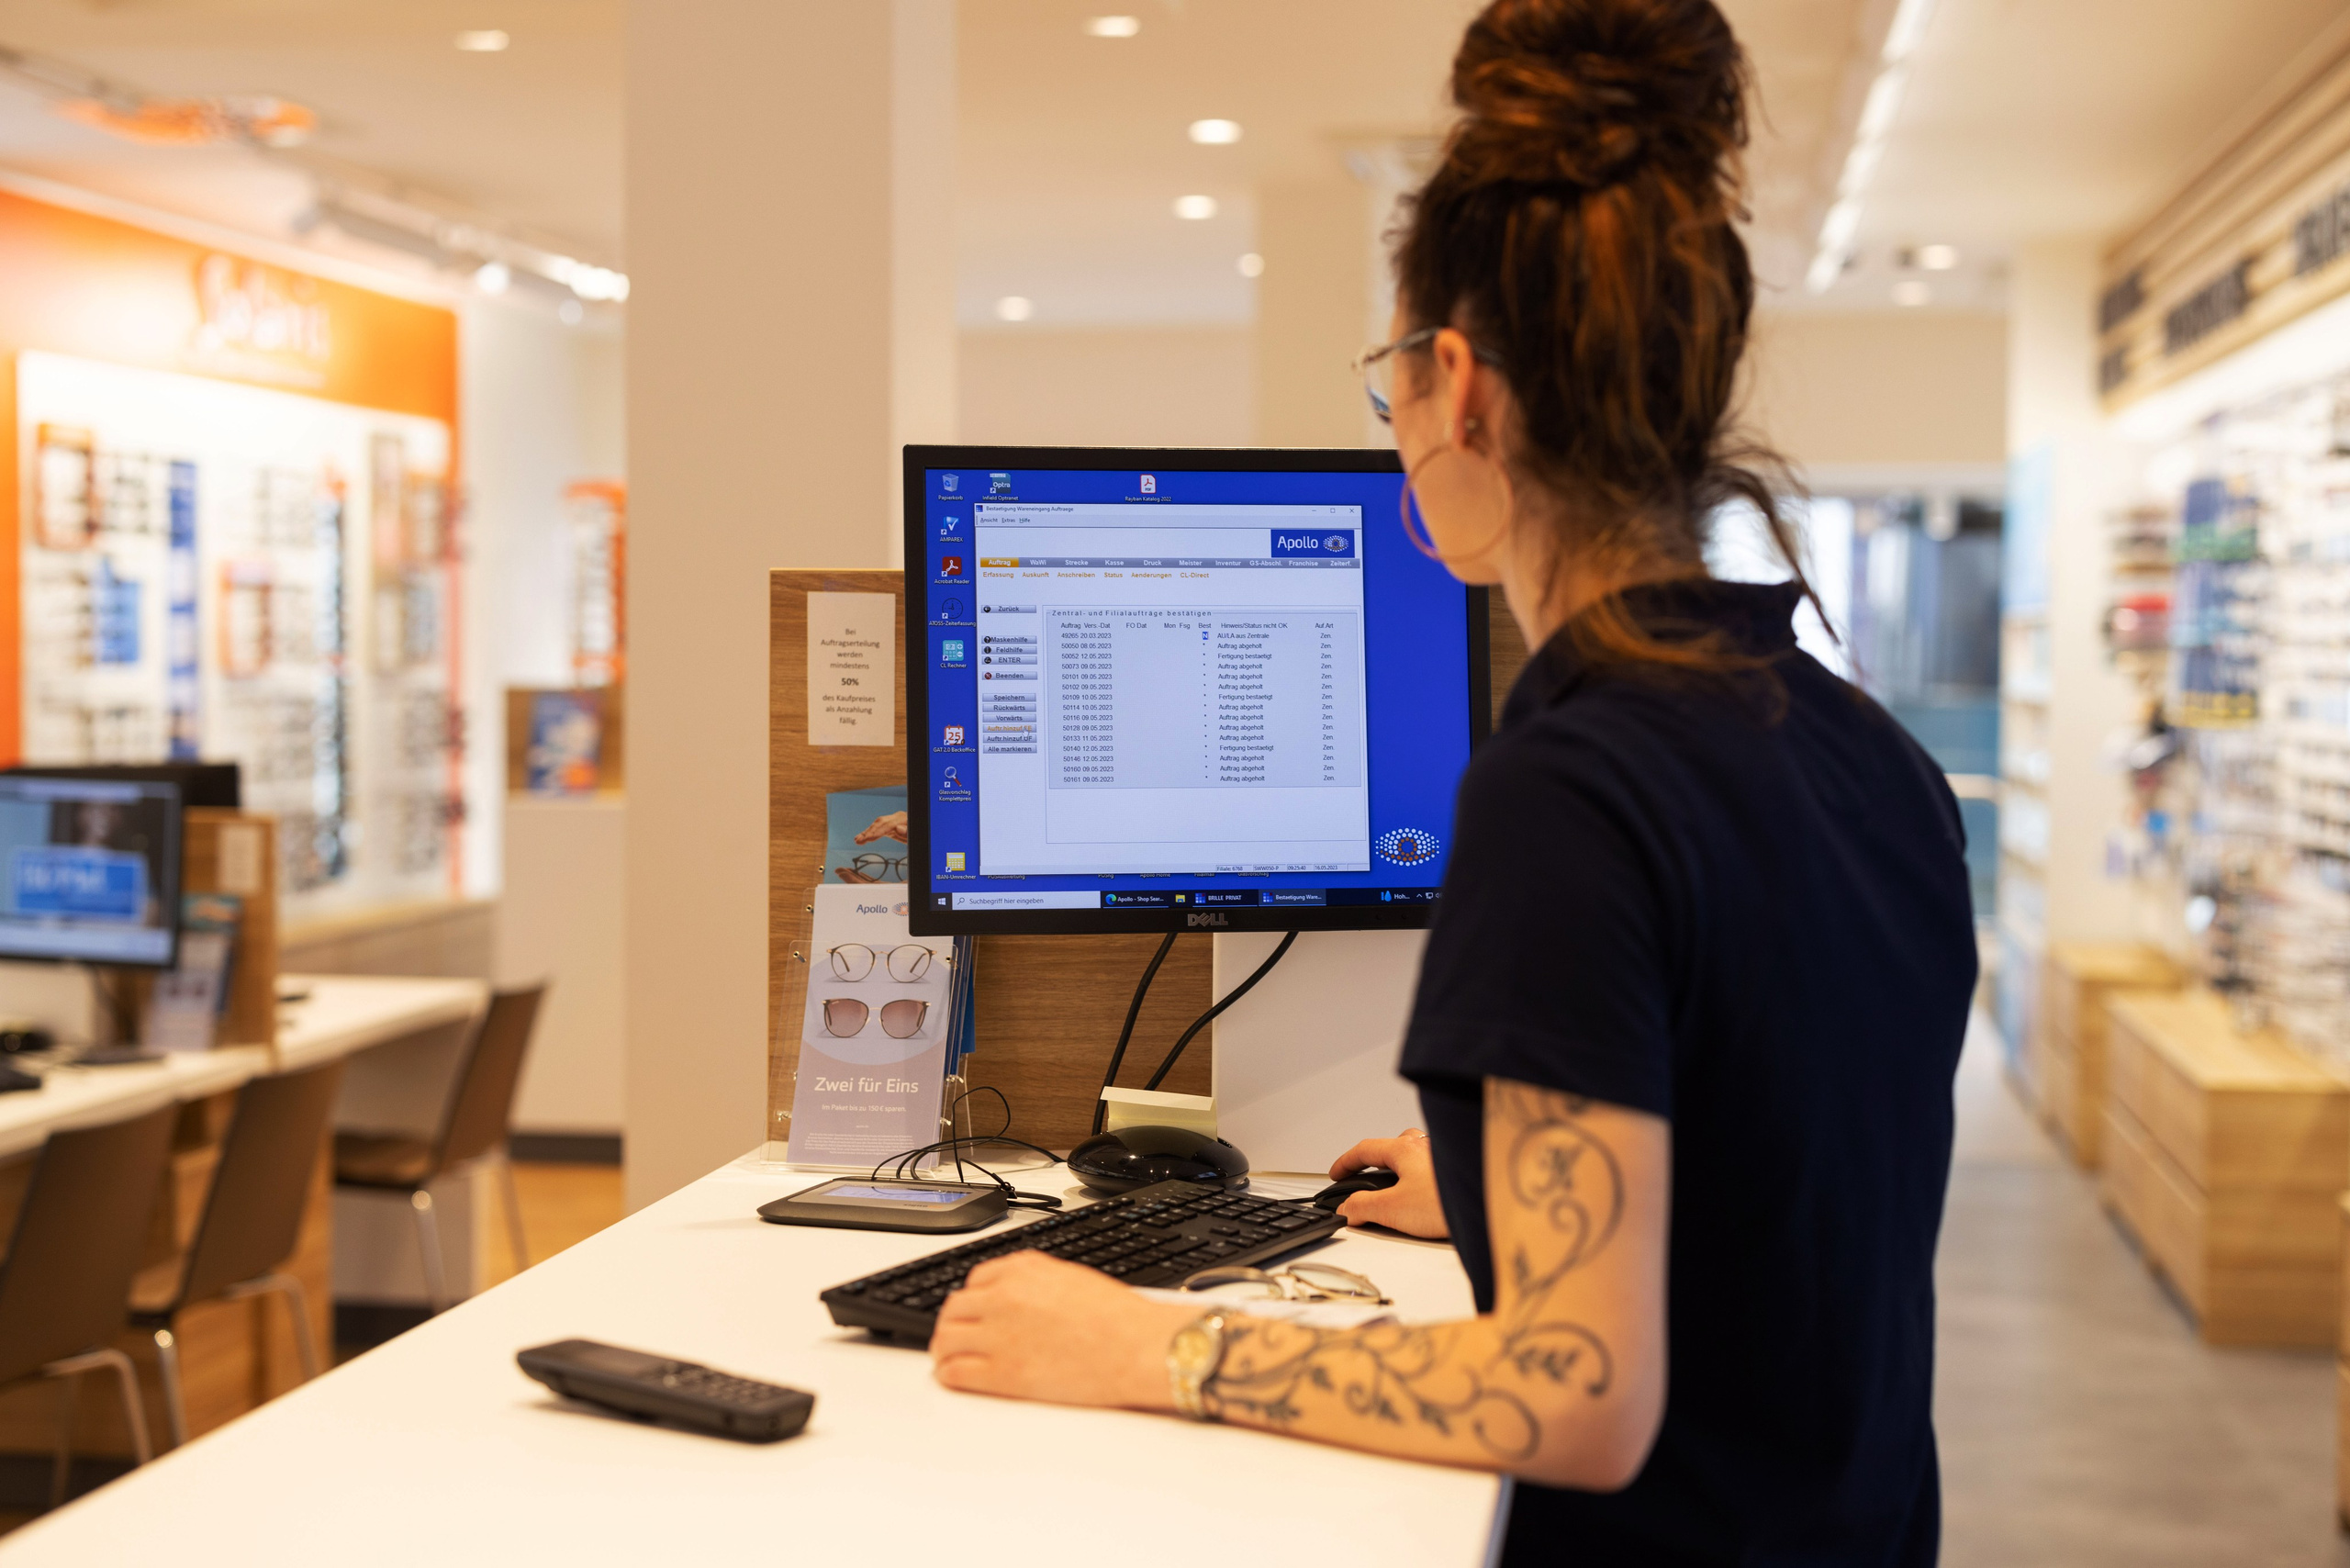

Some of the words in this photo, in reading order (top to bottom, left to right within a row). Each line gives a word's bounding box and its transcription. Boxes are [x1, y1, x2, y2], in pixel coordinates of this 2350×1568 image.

[1277, 535, 1319, 551] Apollo
[821, 639, 880, 648] Auftragserteilung
[830, 662, 869, 670] mindestens
[841, 678, 859, 687] 50%
[822, 694, 834, 702] des
[836, 694, 876, 703] Kaufpreises
[993, 694, 1025, 702] Speichern
[825, 705, 835, 713] als
[836, 706, 873, 714] Anzahlung
[839, 717, 857, 726] fällig.
[969, 898, 1002, 906] Suchbegriff
[856, 903, 889, 915] Apollo
[1187, 912, 1229, 927] DELL
[814, 1077, 856, 1092] Zwei
[858, 1077, 883, 1093] für
[886, 1078, 919, 1093] Eins
